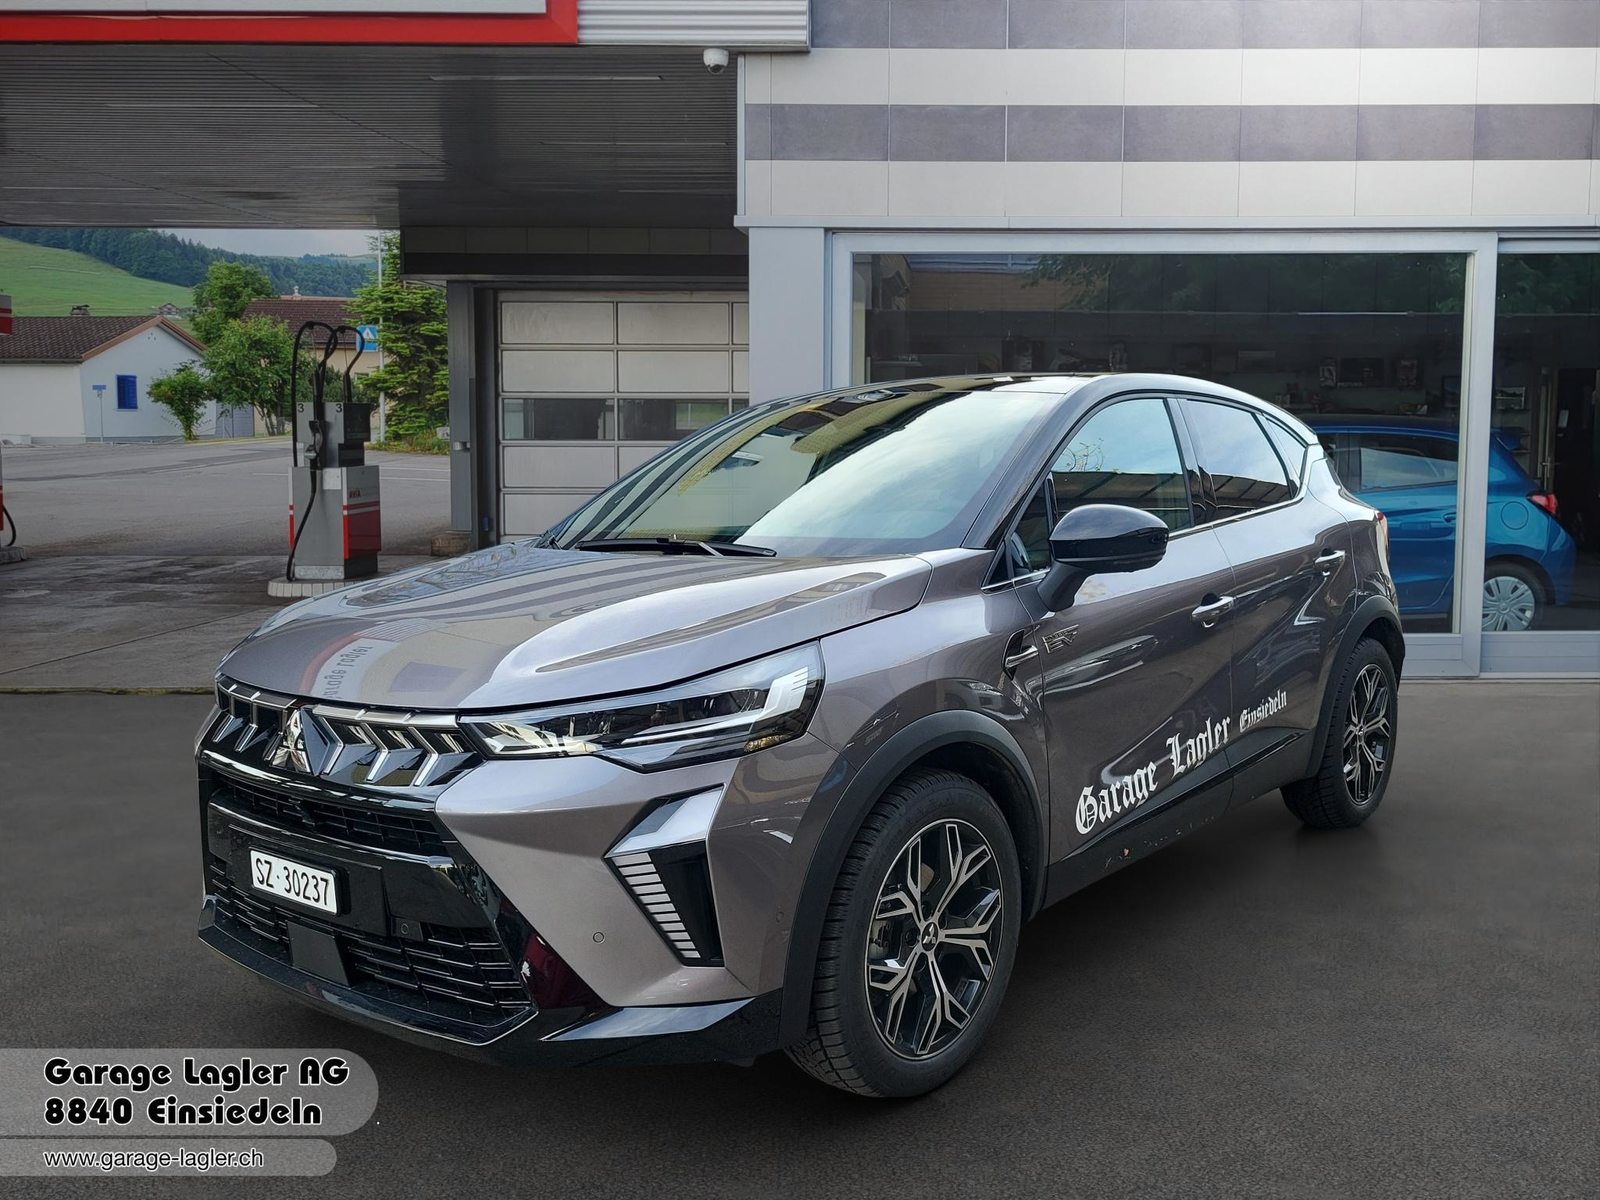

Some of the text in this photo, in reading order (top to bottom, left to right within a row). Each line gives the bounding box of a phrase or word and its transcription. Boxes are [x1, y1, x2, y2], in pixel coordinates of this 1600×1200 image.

[297, 403, 305, 413] 3
[335, 403, 343, 413] 3
[1075, 689, 1288, 835] Garage Lagler Einsiedeln
